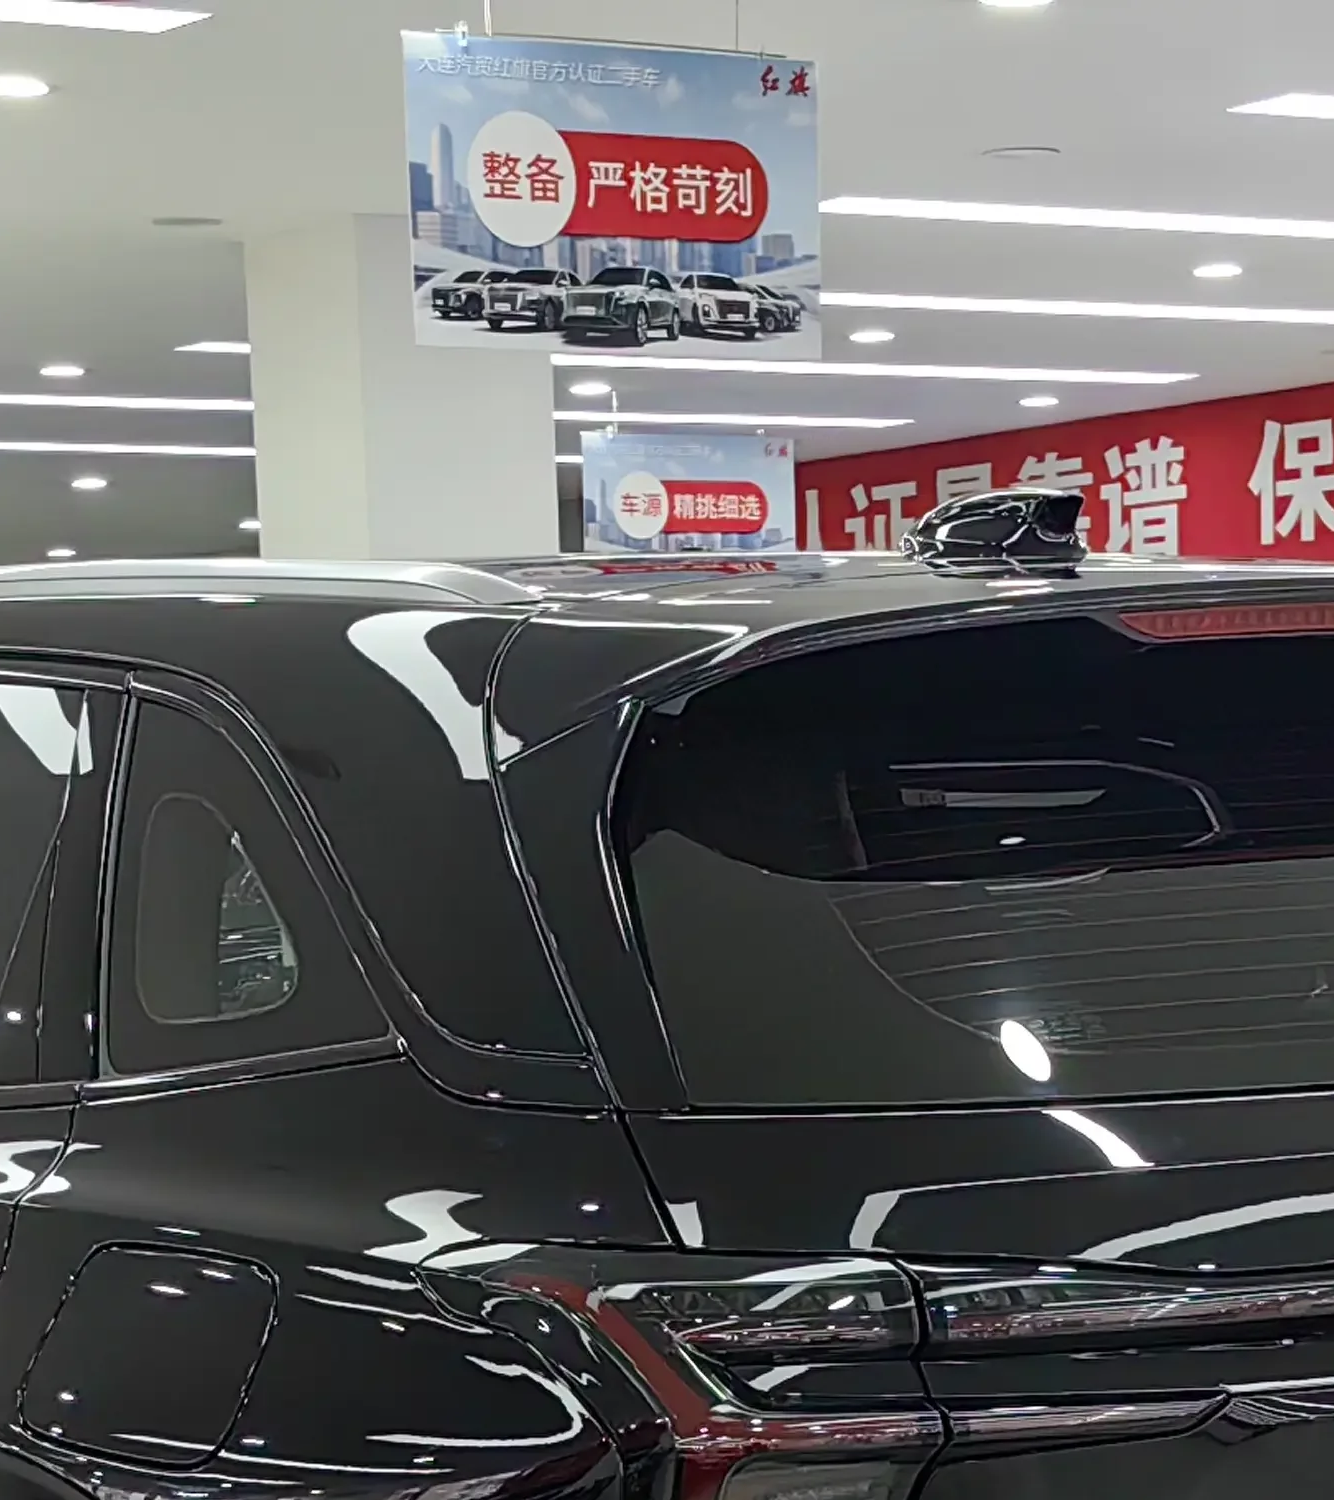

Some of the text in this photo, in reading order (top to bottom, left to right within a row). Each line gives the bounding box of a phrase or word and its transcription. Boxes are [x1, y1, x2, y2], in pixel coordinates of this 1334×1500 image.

[760, 65, 811, 97] 红旗
[482, 150, 753, 217] 整备 严格苛刻
[672, 493, 762, 520] 精挑细选
